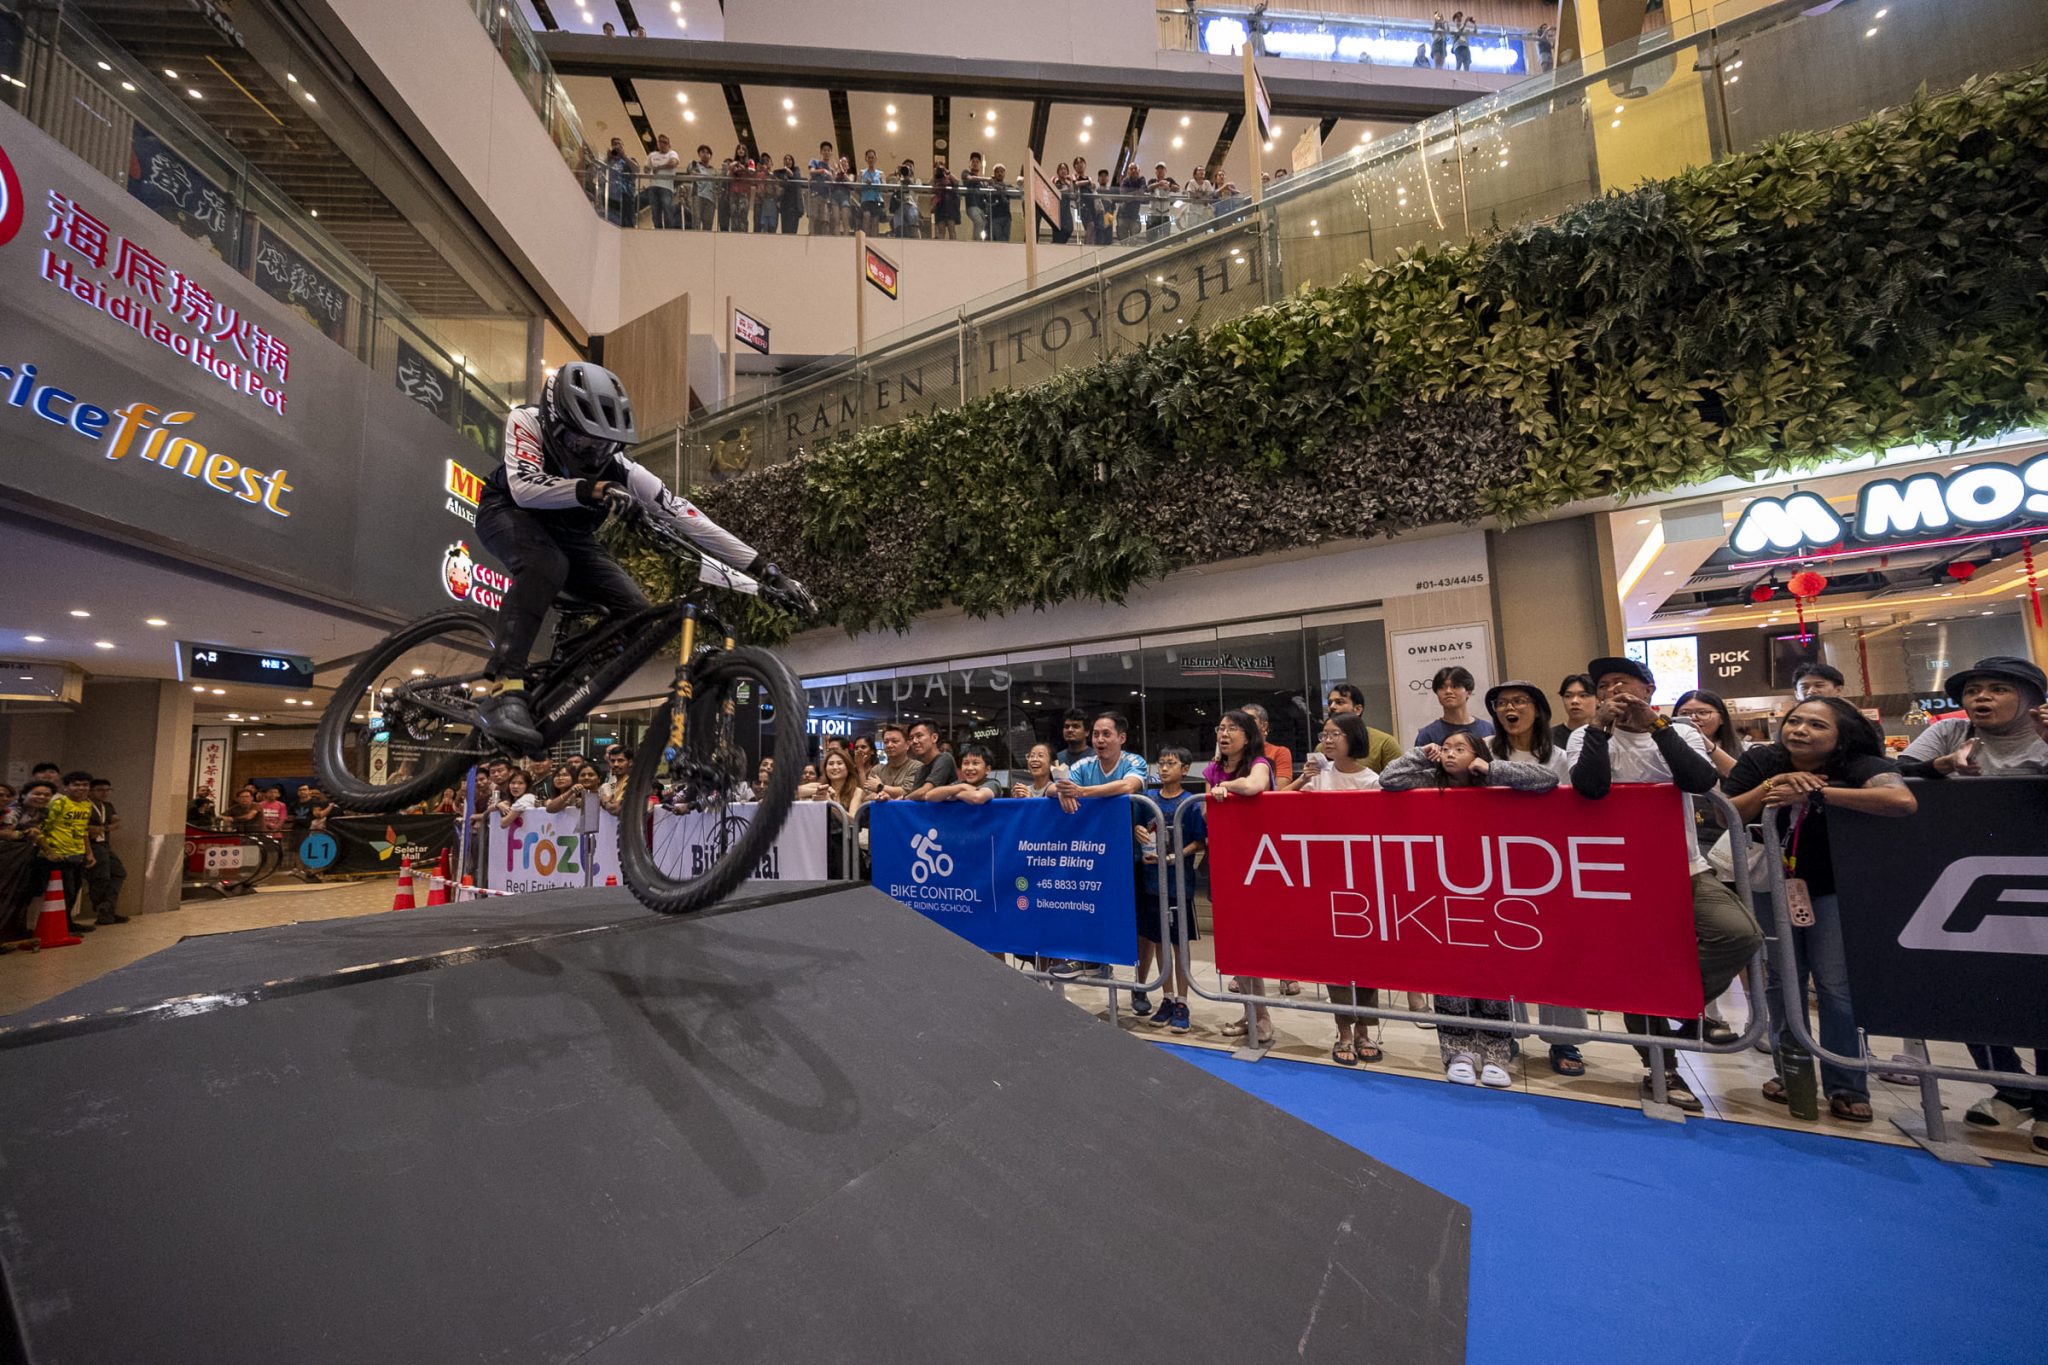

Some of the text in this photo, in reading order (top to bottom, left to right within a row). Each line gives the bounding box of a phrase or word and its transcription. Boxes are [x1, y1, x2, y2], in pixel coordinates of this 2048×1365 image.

[44, 189, 290, 384] 海底捞火锅
[41, 248, 287, 416] Haidilao Hot Pot
[786, 367, 924, 441] RAMEN
[105, 402, 294, 517] finest
[472, 563, 505, 590] COW
[1416, 573, 1484, 590] #01-43/44/45
[1408, 641, 1473, 655] OWNDAYS
[1709, 650, 1750, 664] PICK
[1718, 666, 1742, 677] UP
[307, 843, 330, 860] L1
[394, 845, 428, 854] Seletar
[1018, 840, 1106, 855] Mountain Biking
[401, 852, 420, 861] Mall
[1026, 855, 1094, 871] Trials Biking
[1243, 833, 1632, 900] ATTITUDE
[506, 880, 528, 893] Real
[890, 884, 982, 902] BIKE CONTROL
[1036, 879, 1102, 891] +65 8833 9797
[913, 901, 939, 911] RIDING
[940, 903, 973, 914] SCHOOL
[1036, 898, 1095, 914] bikecontrolsg
[1330, 891, 1543, 950] BIKES
